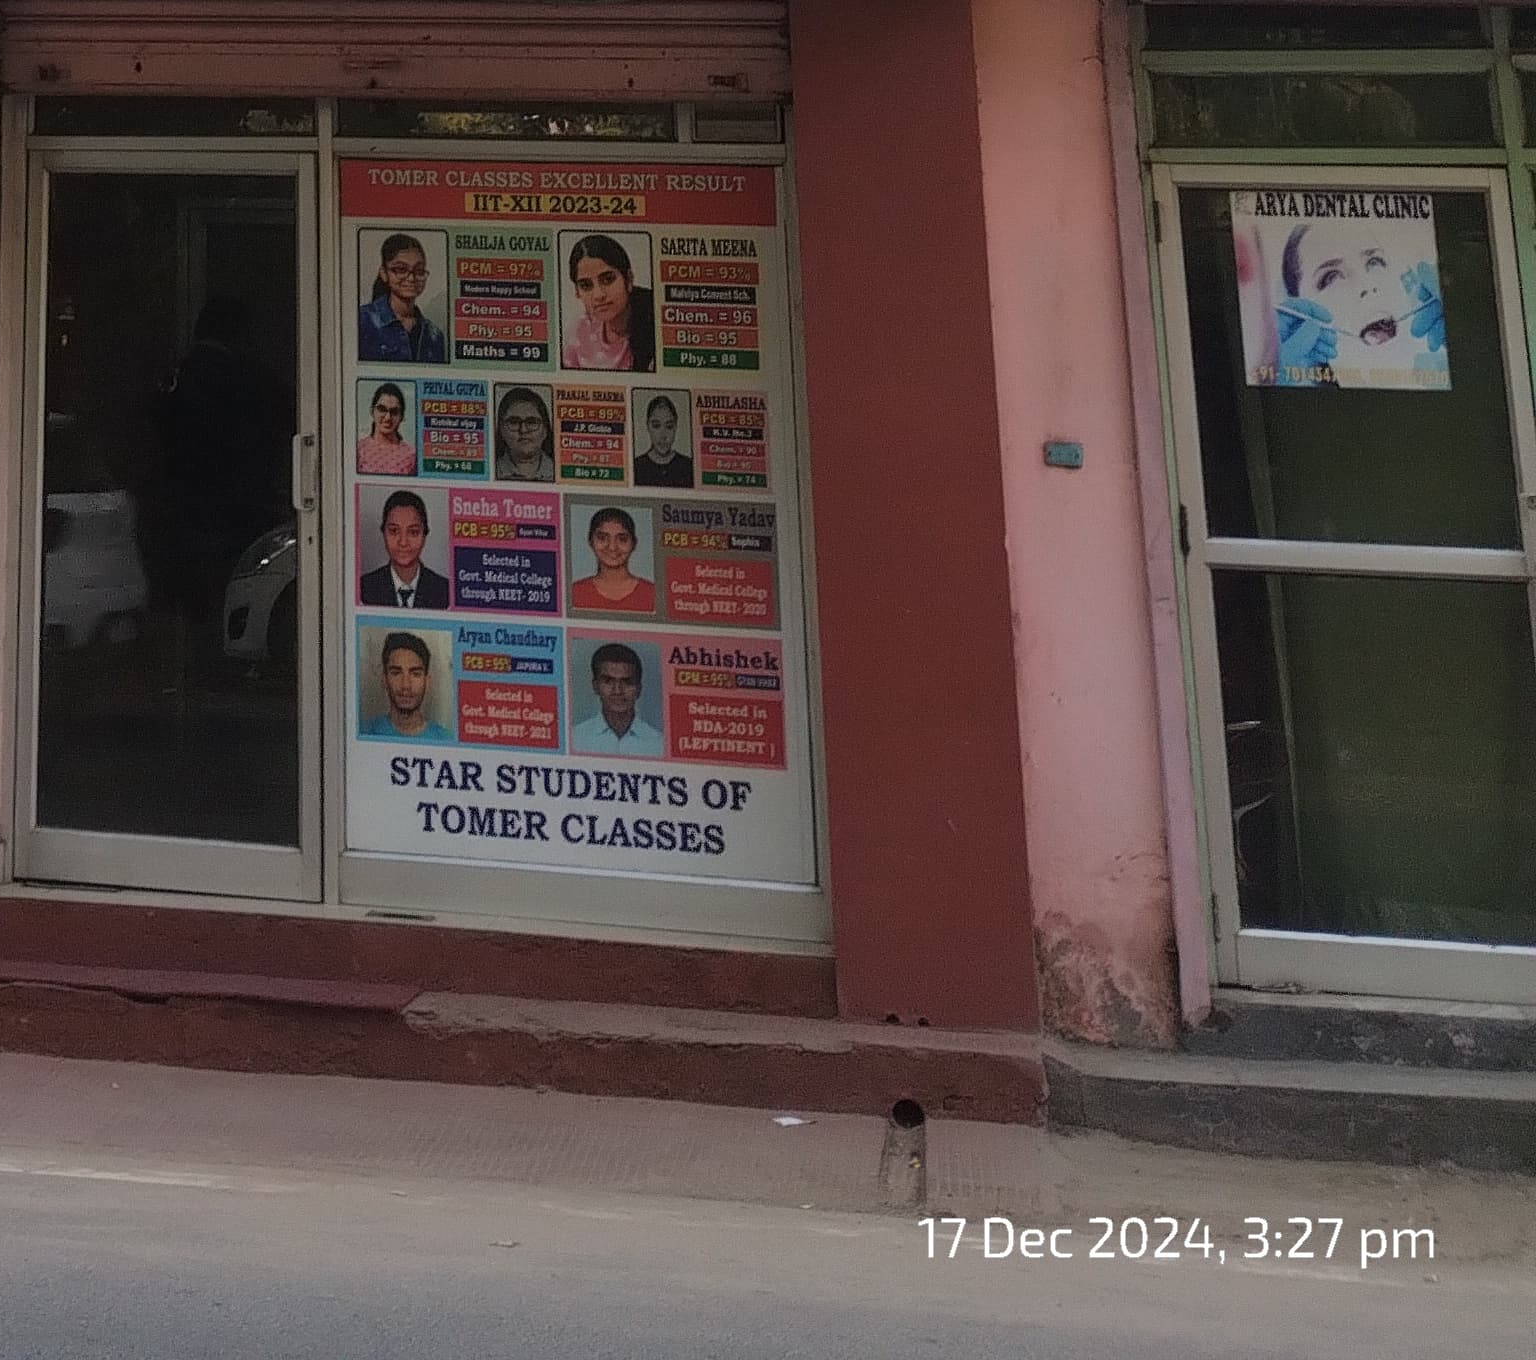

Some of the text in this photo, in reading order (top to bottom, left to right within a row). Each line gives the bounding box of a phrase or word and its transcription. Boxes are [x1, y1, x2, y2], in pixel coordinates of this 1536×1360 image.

[368, 168, 746, 192] TOMER CLASSES EXCELLENT RESULT
[473, 194, 637, 214] IIT-XII 2023-24
[1254, 192, 1431, 220] ARYA DENTAL CLINIC
[456, 234, 551, 252] SHAILJA GOYAL
[661, 237, 758, 258] SARITA MEENA
[460, 262, 492, 274] PCM
[668, 265, 701, 278] PCM
[461, 303, 541, 316] Chem. 94
[665, 308, 752, 324] Chem. 96
[469, 323, 532, 338] Phy. 95
[676, 330, 737, 346] Bio 95
[463, 344, 541, 359] Maths 99
[680, 352, 706, 366] Phy.
[424, 402, 448, 413] PCB
[696, 394, 767, 409] ABHILASHA
[464, 432, 479, 444] 95
[453, 496, 553, 520] Sneha Tomer
[662, 503, 775, 529] Saumya Yadav
[454, 522, 478, 536] PCB
[664, 532, 689, 547] PCB
[482, 553, 531, 568] Selected in
[458, 569, 553, 589] Govt. Medical College
[461, 586, 497, 602] through
[527, 590, 551, 603] 2019
[458, 626, 558, 653] Aryan Chaudhary
[669, 646, 779, 671] Abhishek
[688, 702, 767, 719] Selected in
[693, 720, 765, 736] NDA-2019
[390, 756, 752, 811] STAR STUDENTS OF
[417, 801, 726, 856] TOMER CLASSES
